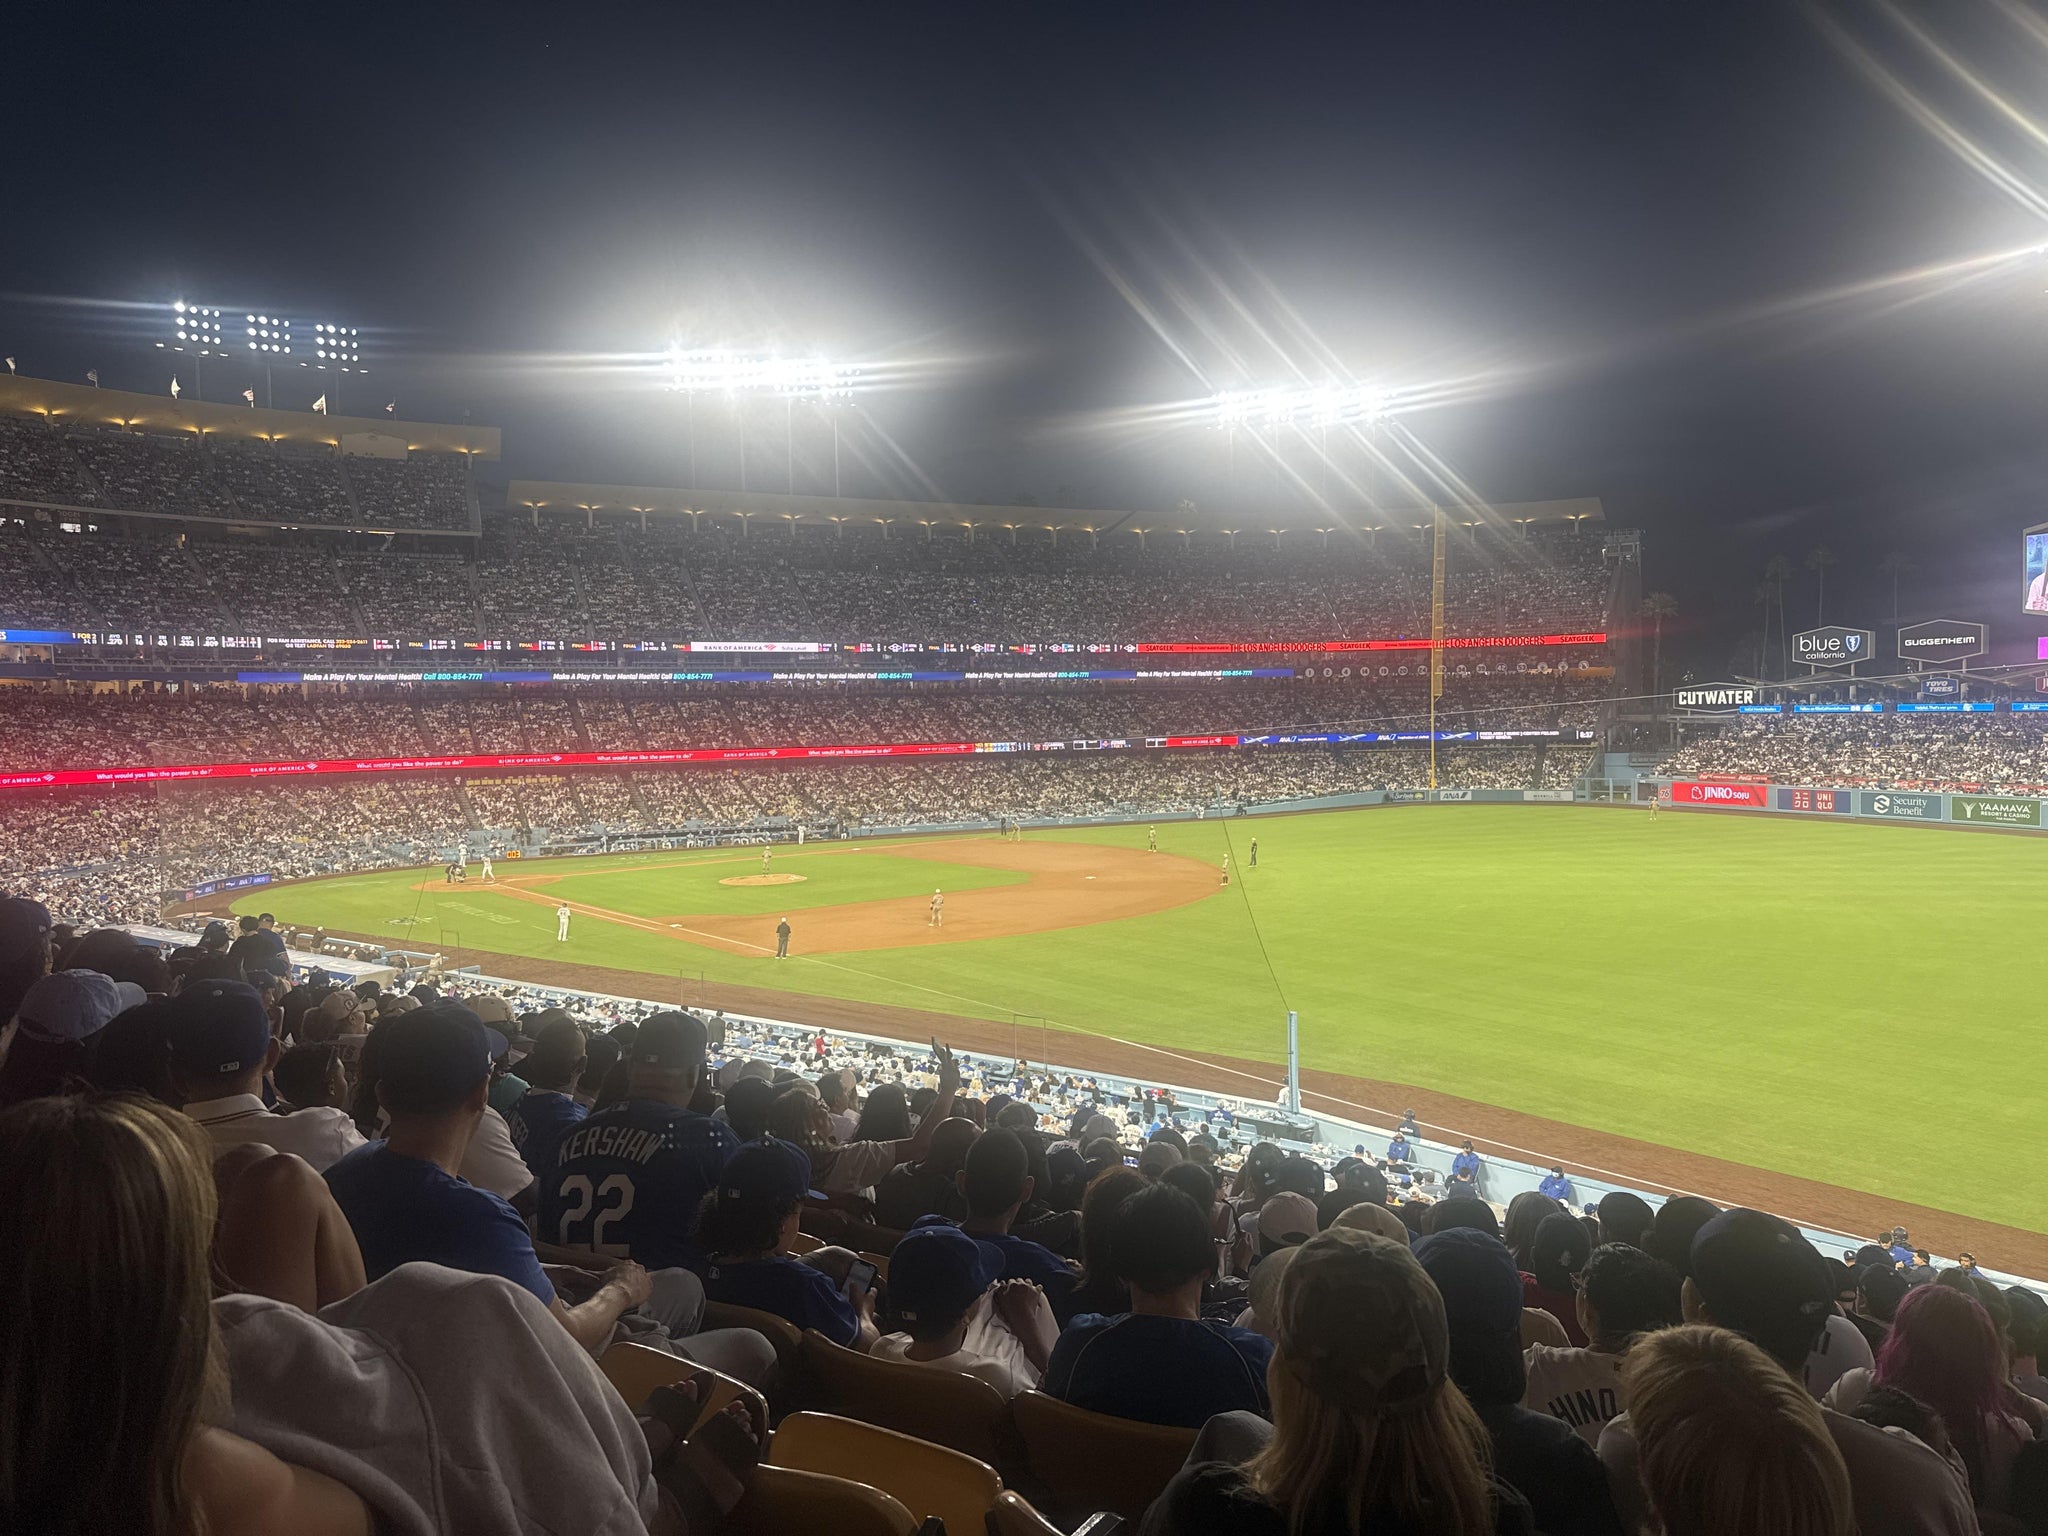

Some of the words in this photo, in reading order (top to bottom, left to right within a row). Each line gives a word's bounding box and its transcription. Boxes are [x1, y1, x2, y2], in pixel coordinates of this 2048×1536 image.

[1231, 644, 1244, 652] THE
[1245, 643, 1257, 652] LOS
[1258, 643, 1290, 651] ANGELES
[1290, 642, 1326, 651] DODGERS
[1451, 639, 1465, 648] LOS
[1466, 638, 1504, 647] ANGELES
[1504, 636, 1544, 646] DODGERS
[1800, 636, 1840, 651] blue
[1904, 636, 1975, 646] GUGGENHEIM
[330, 673, 345, 682] Play
[1679, 690, 1753, 704] CUTWATER
[1704, 787, 1732, 800] JINRO
[1893, 796, 1927, 808] Security
[1894, 806, 1923, 816] Benefit
[558, 1126, 664, 1167] KERSHAW
[559, 1174, 635, 1258] 22
